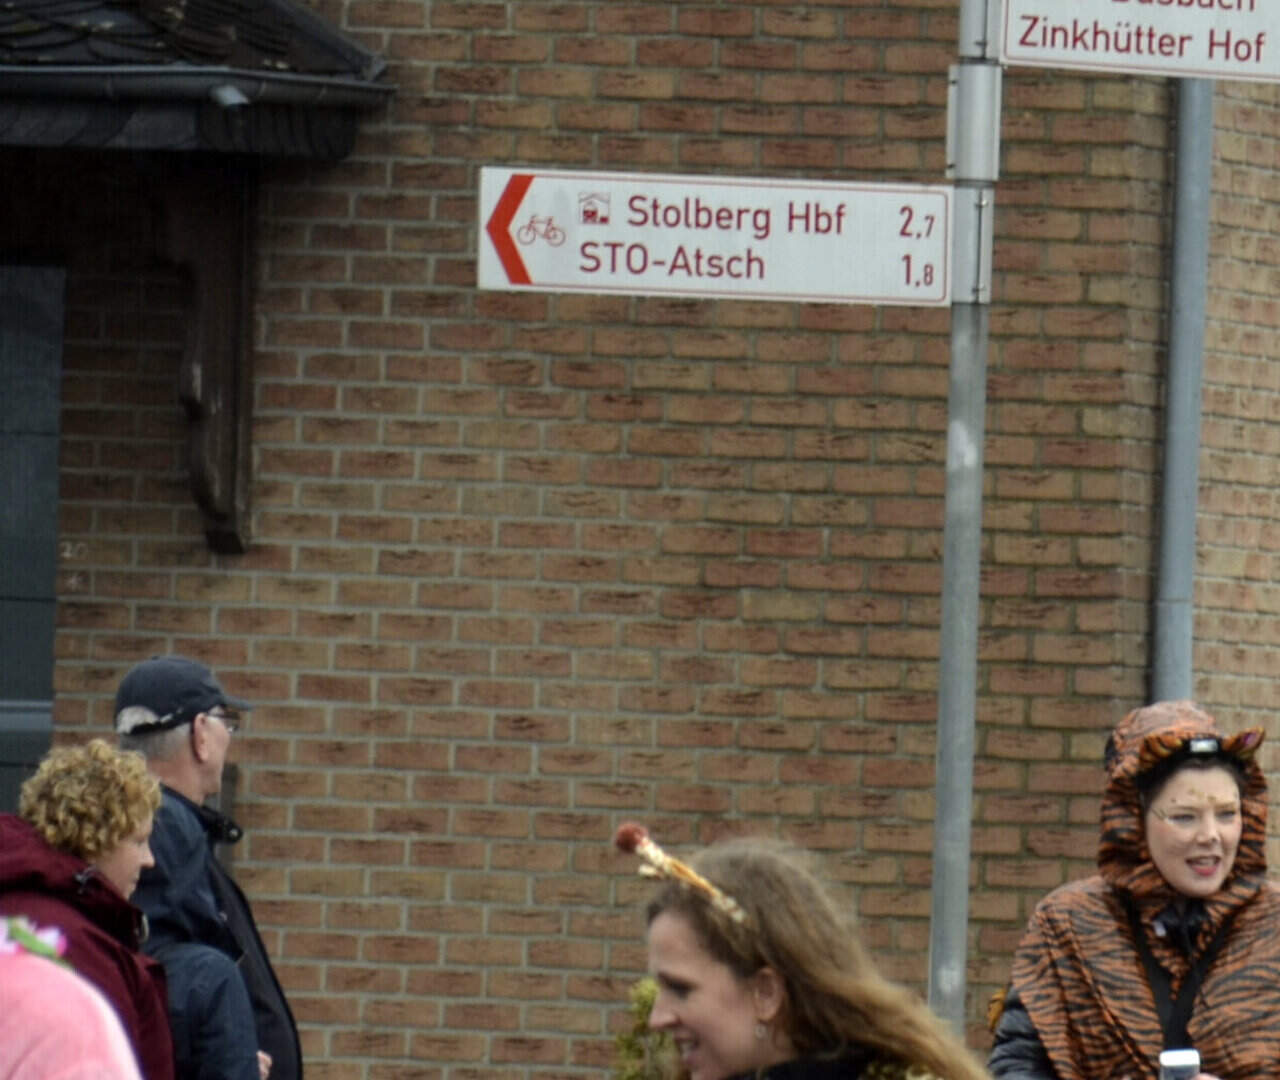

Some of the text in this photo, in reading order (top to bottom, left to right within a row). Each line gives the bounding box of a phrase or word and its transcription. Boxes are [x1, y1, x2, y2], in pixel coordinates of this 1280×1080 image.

[1018, 15, 1193, 58] Zinkhütter
[1207, 29, 1267, 63] Hof
[627, 194, 773, 238] Stolberg
[787, 201, 846, 236] Hbf
[579, 240, 766, 281] STO-Atsch
